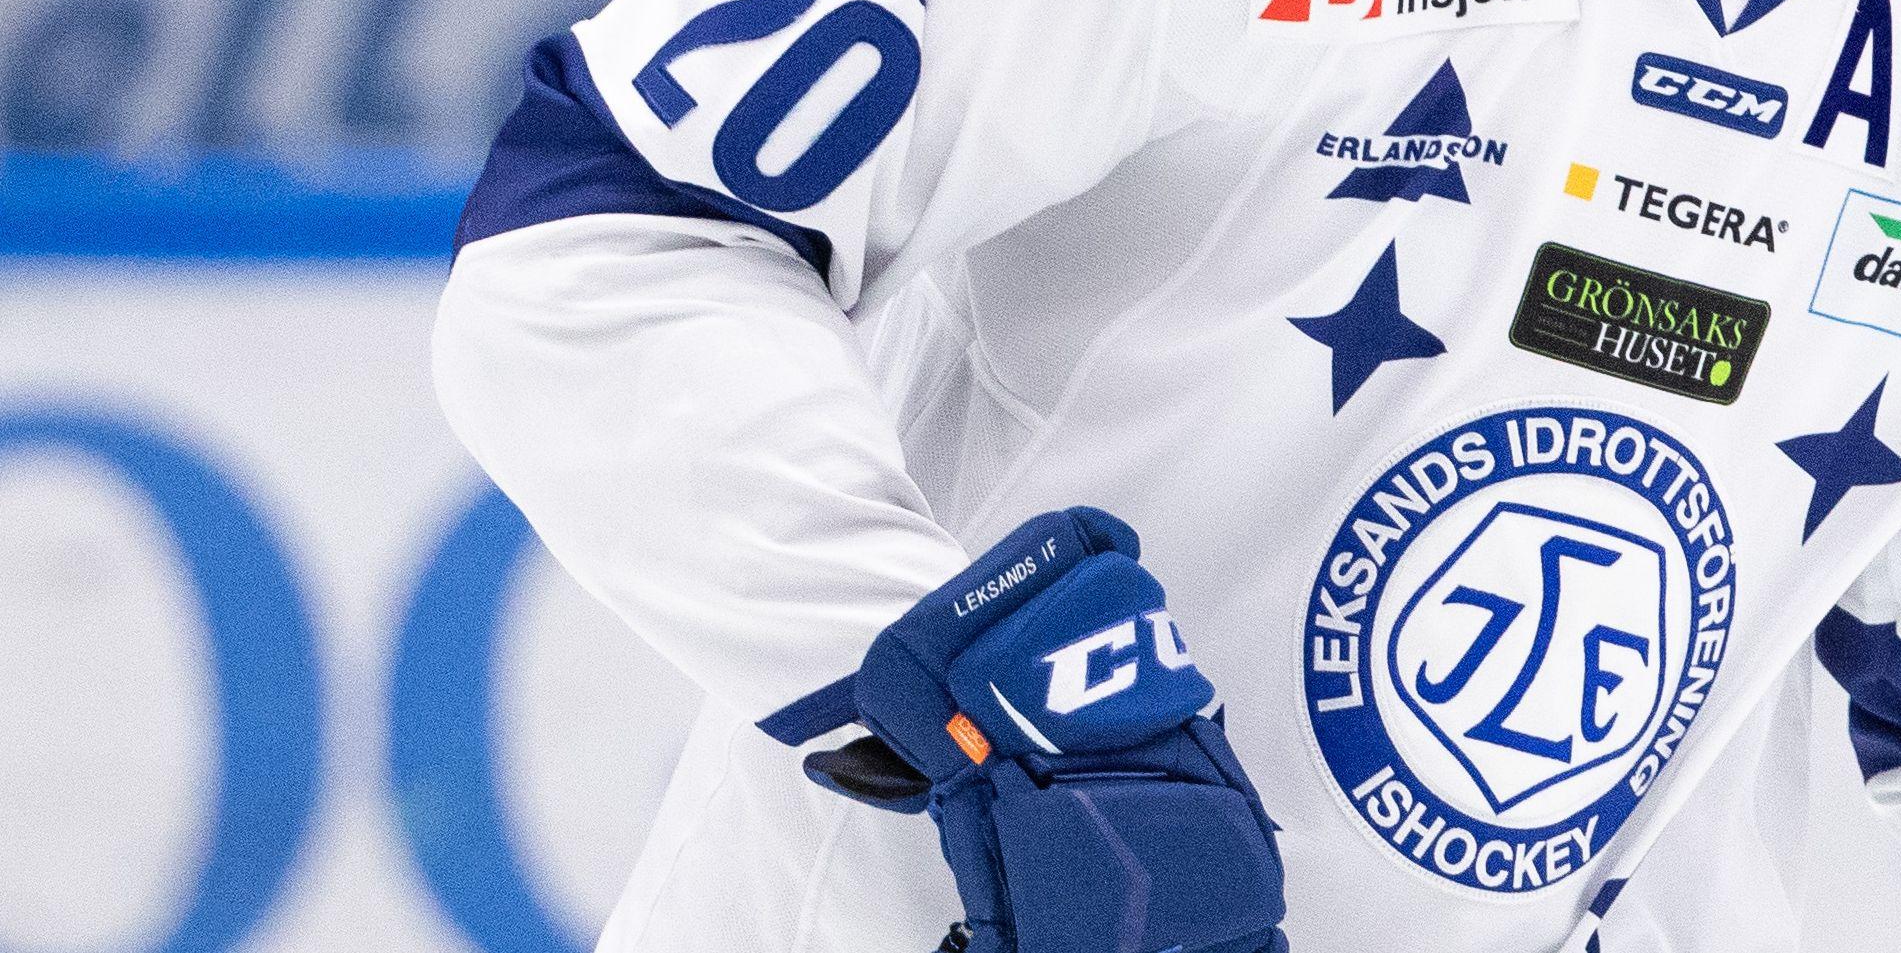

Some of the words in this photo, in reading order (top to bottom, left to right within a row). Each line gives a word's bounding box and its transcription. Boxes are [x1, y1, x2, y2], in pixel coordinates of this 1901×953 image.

[1638, 64, 1783, 125] CCM
[1316, 132, 1509, 167] ERLANDSON
[1546, 269, 1748, 349] GRÖNSAKS
[1592, 321, 1717, 382] HUSET
[954, 557, 1038, 617] LEKSANDS
[1040, 538, 1059, 562] IF
[1313, 430, 1498, 713] LEKSANDS
[1506, 416, 1737, 799] IDROTTSFÖRENING
[1352, 766, 1600, 890] ISHOCKEY
